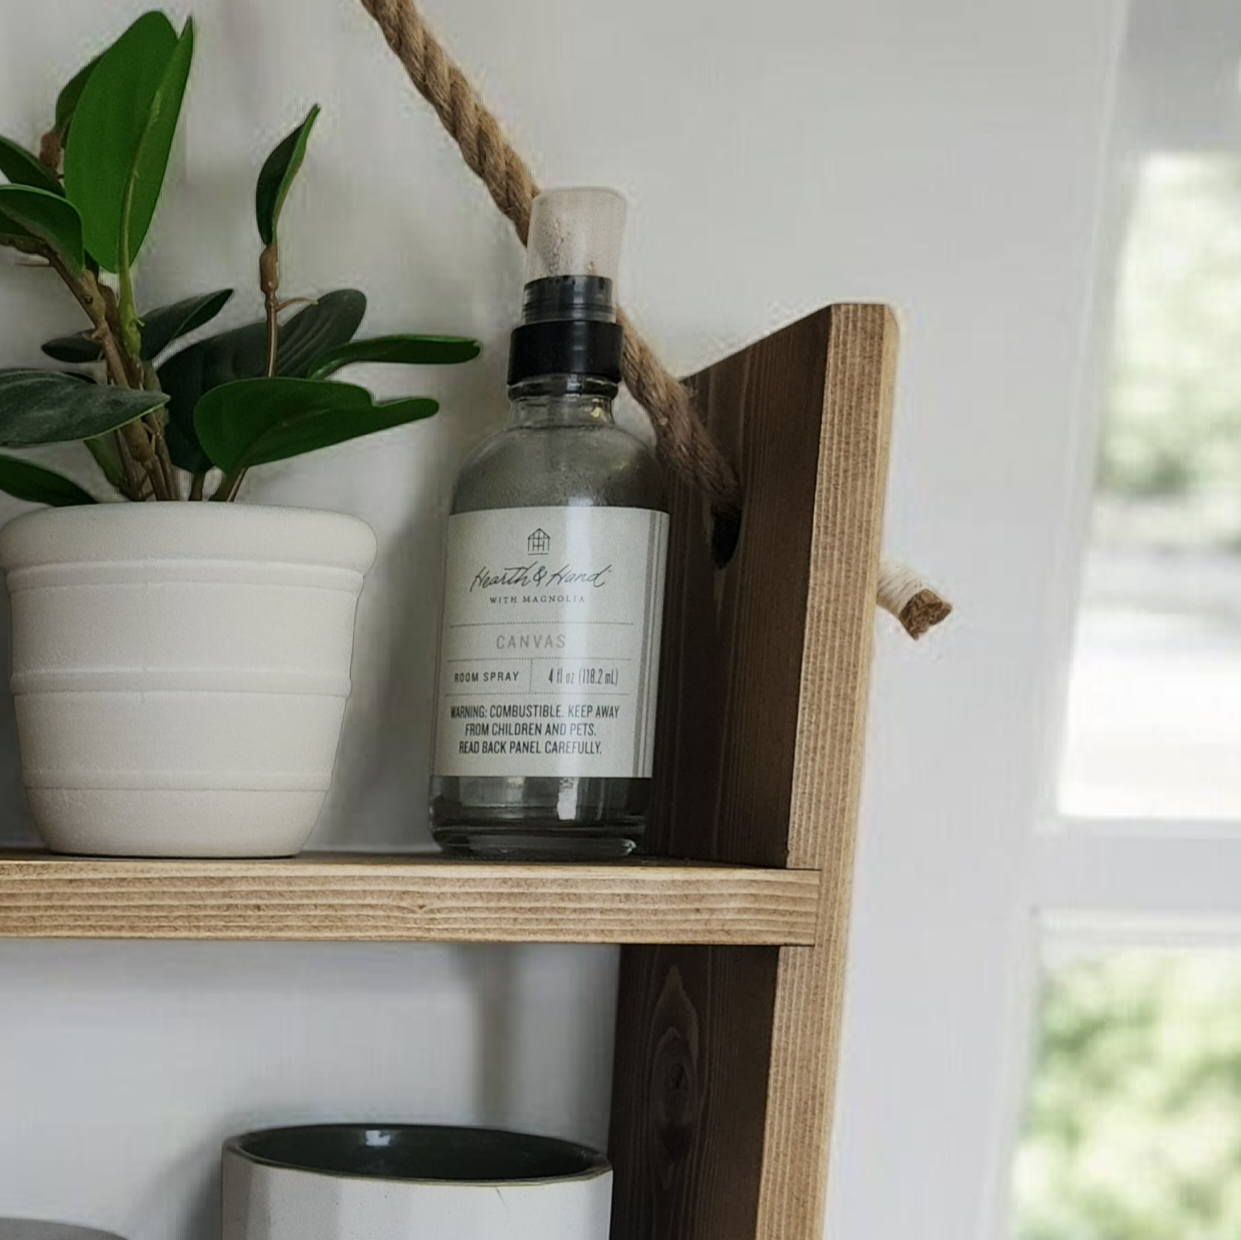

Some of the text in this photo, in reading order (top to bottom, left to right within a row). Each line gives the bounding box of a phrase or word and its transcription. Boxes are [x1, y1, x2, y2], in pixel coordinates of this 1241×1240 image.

[469, 561, 612, 593] Hearth & Hand
[489, 595, 586, 604] WITH MAGNOLIA
[496, 634, 566, 649] CANVAS
[454, 671, 520, 683] ROOM SPRAY
[548, 668, 619, 686] 4 fl oz (118.2 mL)
[450, 704, 620, 719] WARNING: COMBUSTIBLE. KEEP AWAY
[465, 723, 597, 736] FROM CHILDREN AND PETS.
[459, 741, 602, 755] READ BACK PANEL CAREFULLY.
